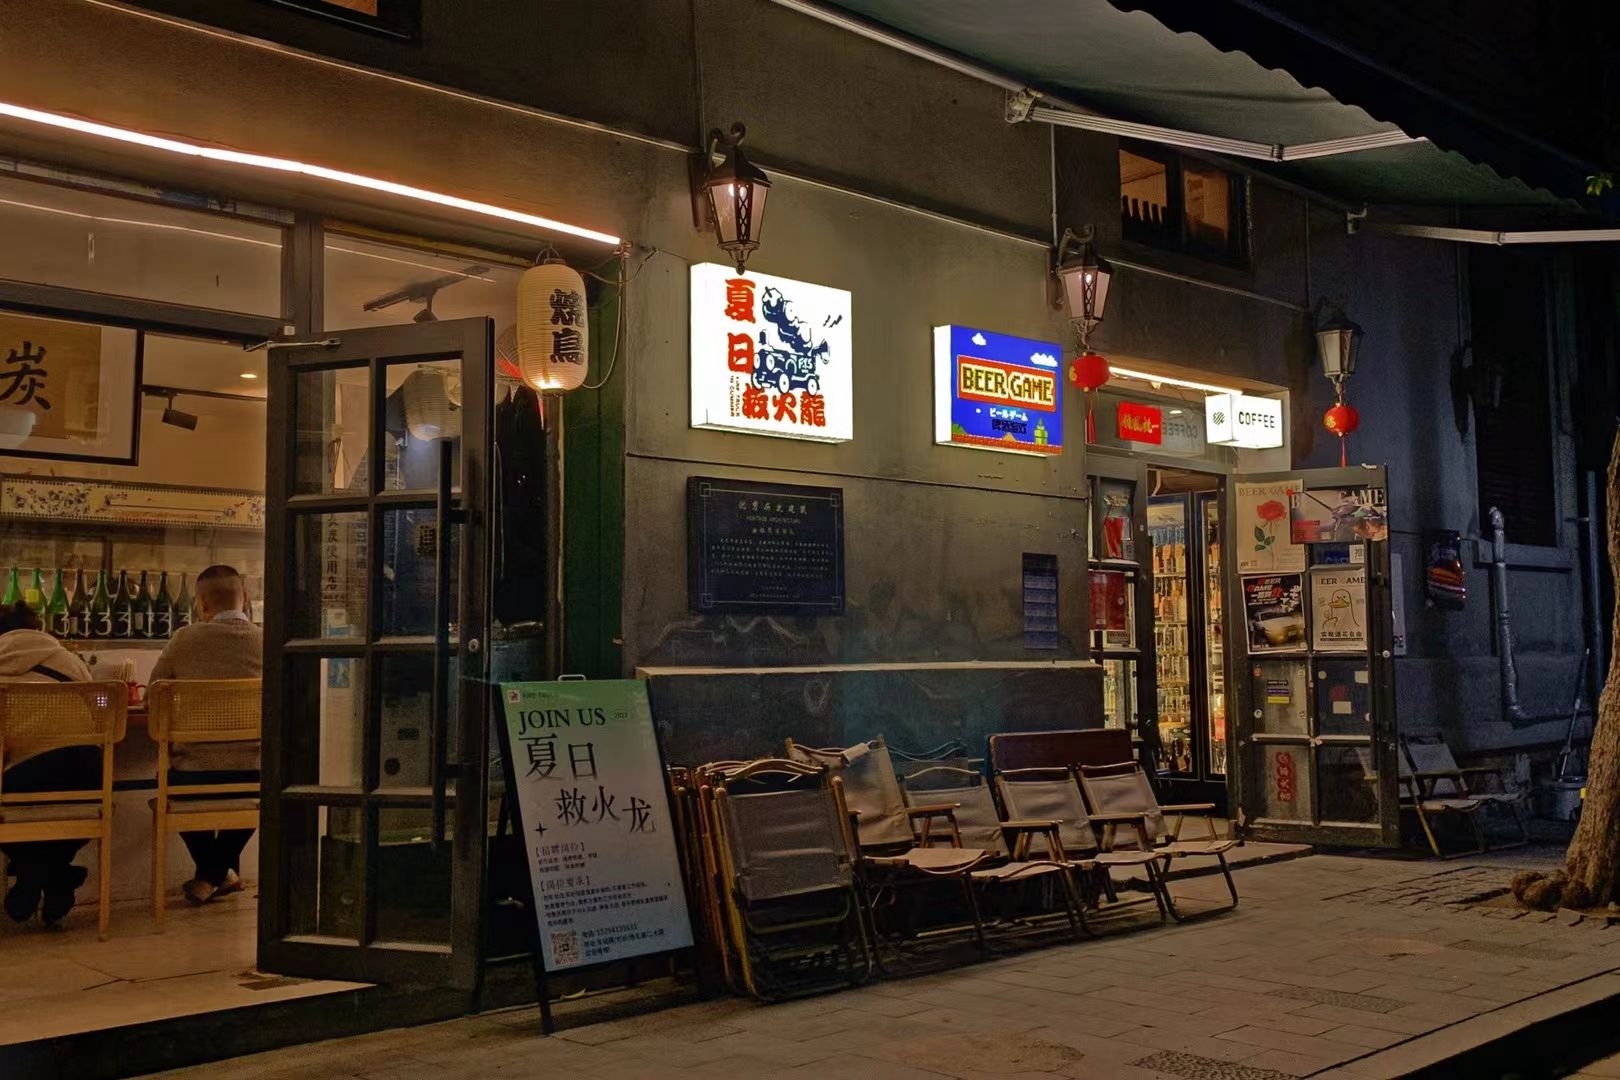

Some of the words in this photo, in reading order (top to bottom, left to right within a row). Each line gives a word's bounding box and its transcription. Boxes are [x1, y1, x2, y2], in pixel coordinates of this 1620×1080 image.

[725, 278, 757, 374] 夏日
[0, 340, 51, 410] 炭
[963, 366, 1006, 395] BEER
[1010, 374, 1053, 403] GAME
[742, 382, 826, 427] 救火龍
[989, 407, 1028, 421] ビールゲーム
[1238, 411, 1276, 429] COFFEE
[518, 709, 570, 735] JOIN
[576, 707, 606, 726] US
[518, 733, 598, 782] 夏日
[554, 785, 657, 834] 救火龙
